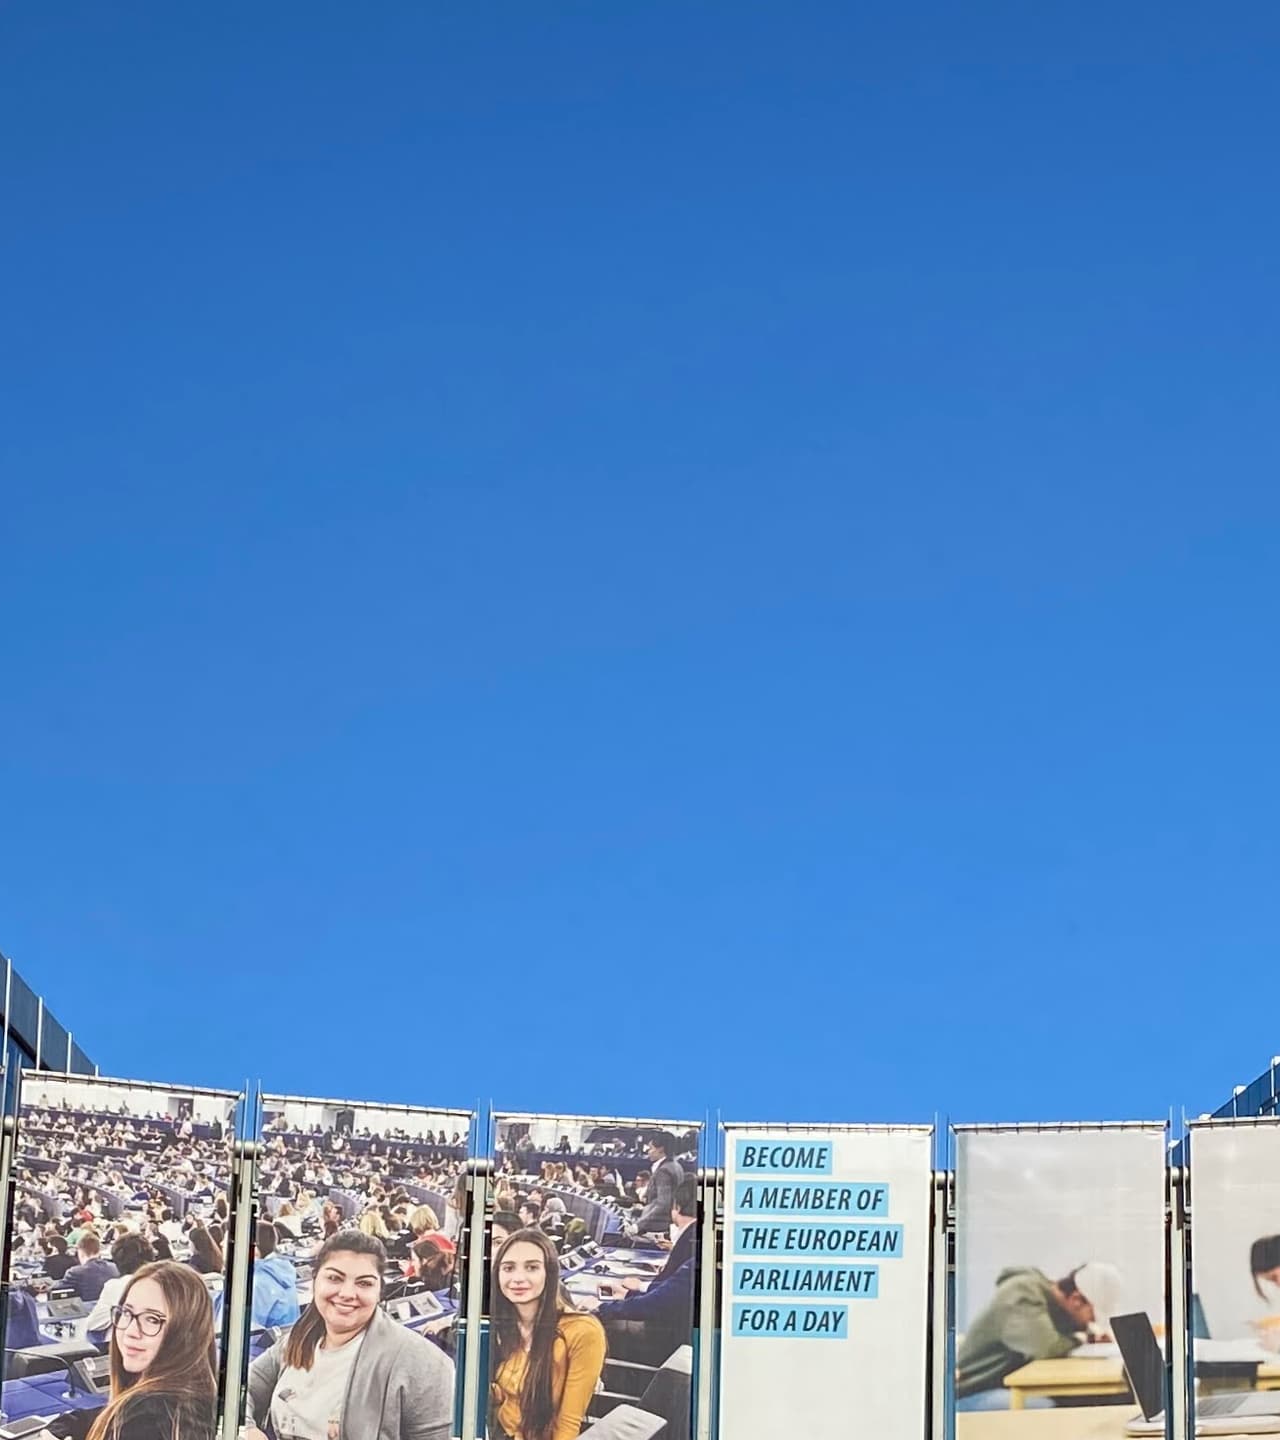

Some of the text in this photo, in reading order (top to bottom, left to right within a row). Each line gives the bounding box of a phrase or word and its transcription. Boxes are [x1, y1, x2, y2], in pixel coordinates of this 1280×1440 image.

[742, 1146, 828, 1168] BECOME
[740, 1187, 884, 1211] A MEMBER OF
[742, 1228, 898, 1252] THE EUROPEAN
[739, 1269, 875, 1292] PARLIAMENT
[739, 1309, 845, 1332] FOR A DAY
